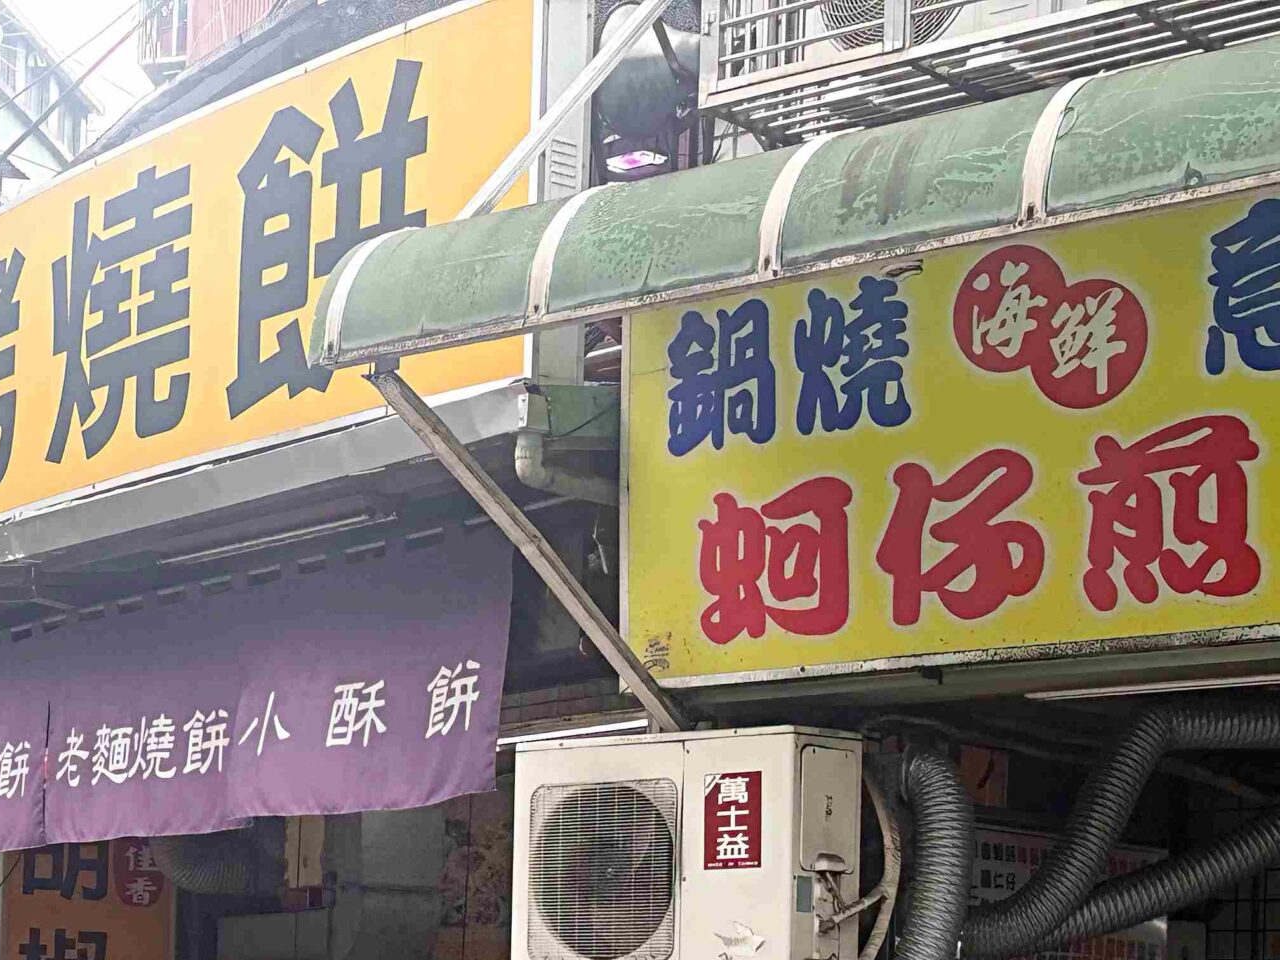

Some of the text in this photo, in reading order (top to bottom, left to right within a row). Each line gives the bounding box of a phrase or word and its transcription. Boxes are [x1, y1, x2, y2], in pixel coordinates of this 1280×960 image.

[667, 276, 912, 457] 鍋燒
[970, 260, 1129, 394] 海鮮
[699, 415, 1261, 645] 蚵仔煎
[55, 709, 231, 788] 老麵燒餅
[238, 660, 481, 756] 小酥餅
[716, 776, 750, 860] 萬士益
